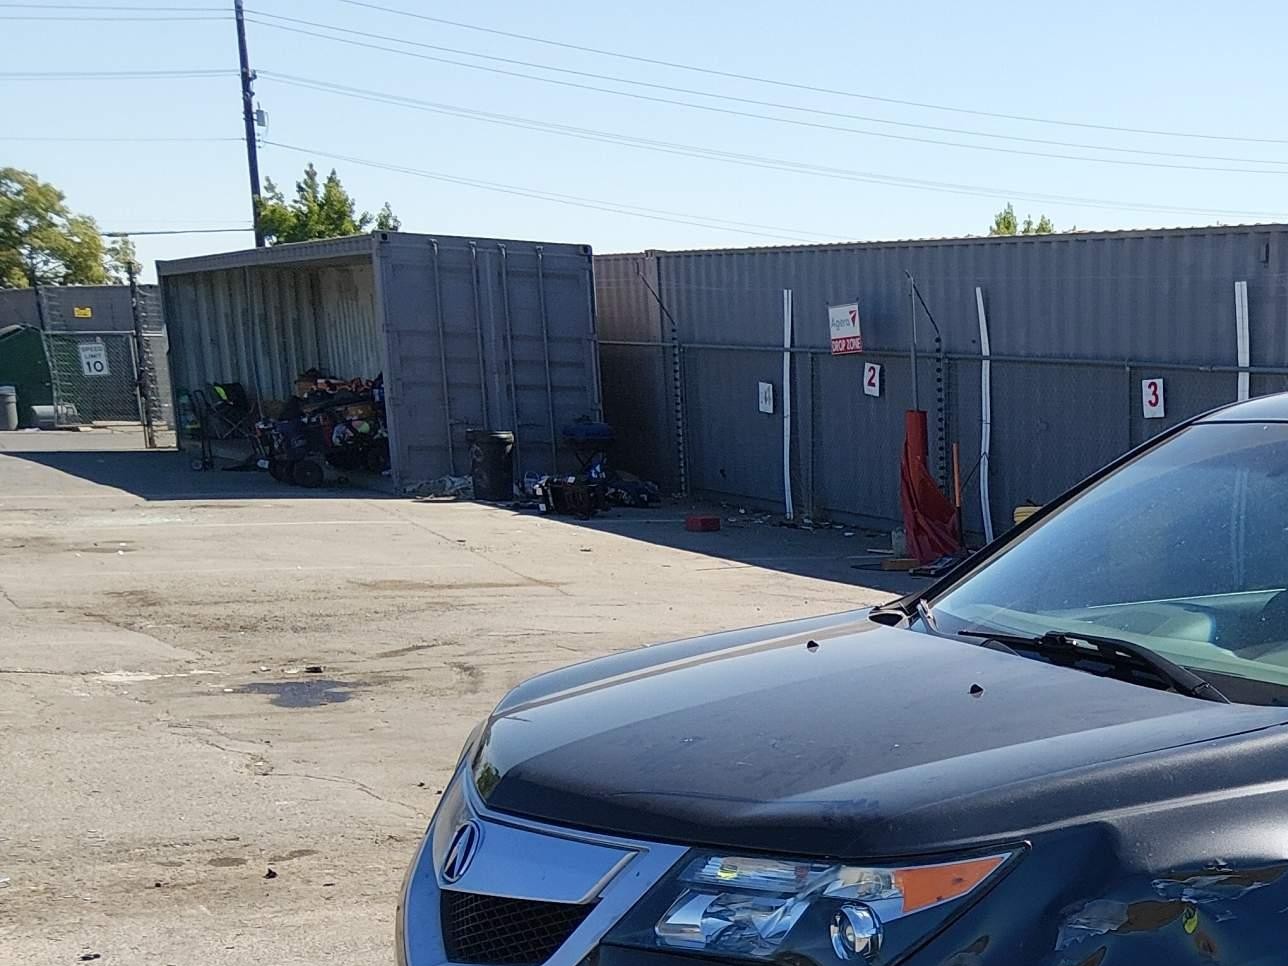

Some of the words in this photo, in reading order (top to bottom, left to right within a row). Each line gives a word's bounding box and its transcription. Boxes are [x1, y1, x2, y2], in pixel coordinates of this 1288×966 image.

[832, 338, 847, 352] DROP
[847, 336, 862, 351] ZONE
[86, 360, 104, 373] 10
[867, 366, 876, 388] 2
[1147, 381, 1159, 407] 3
